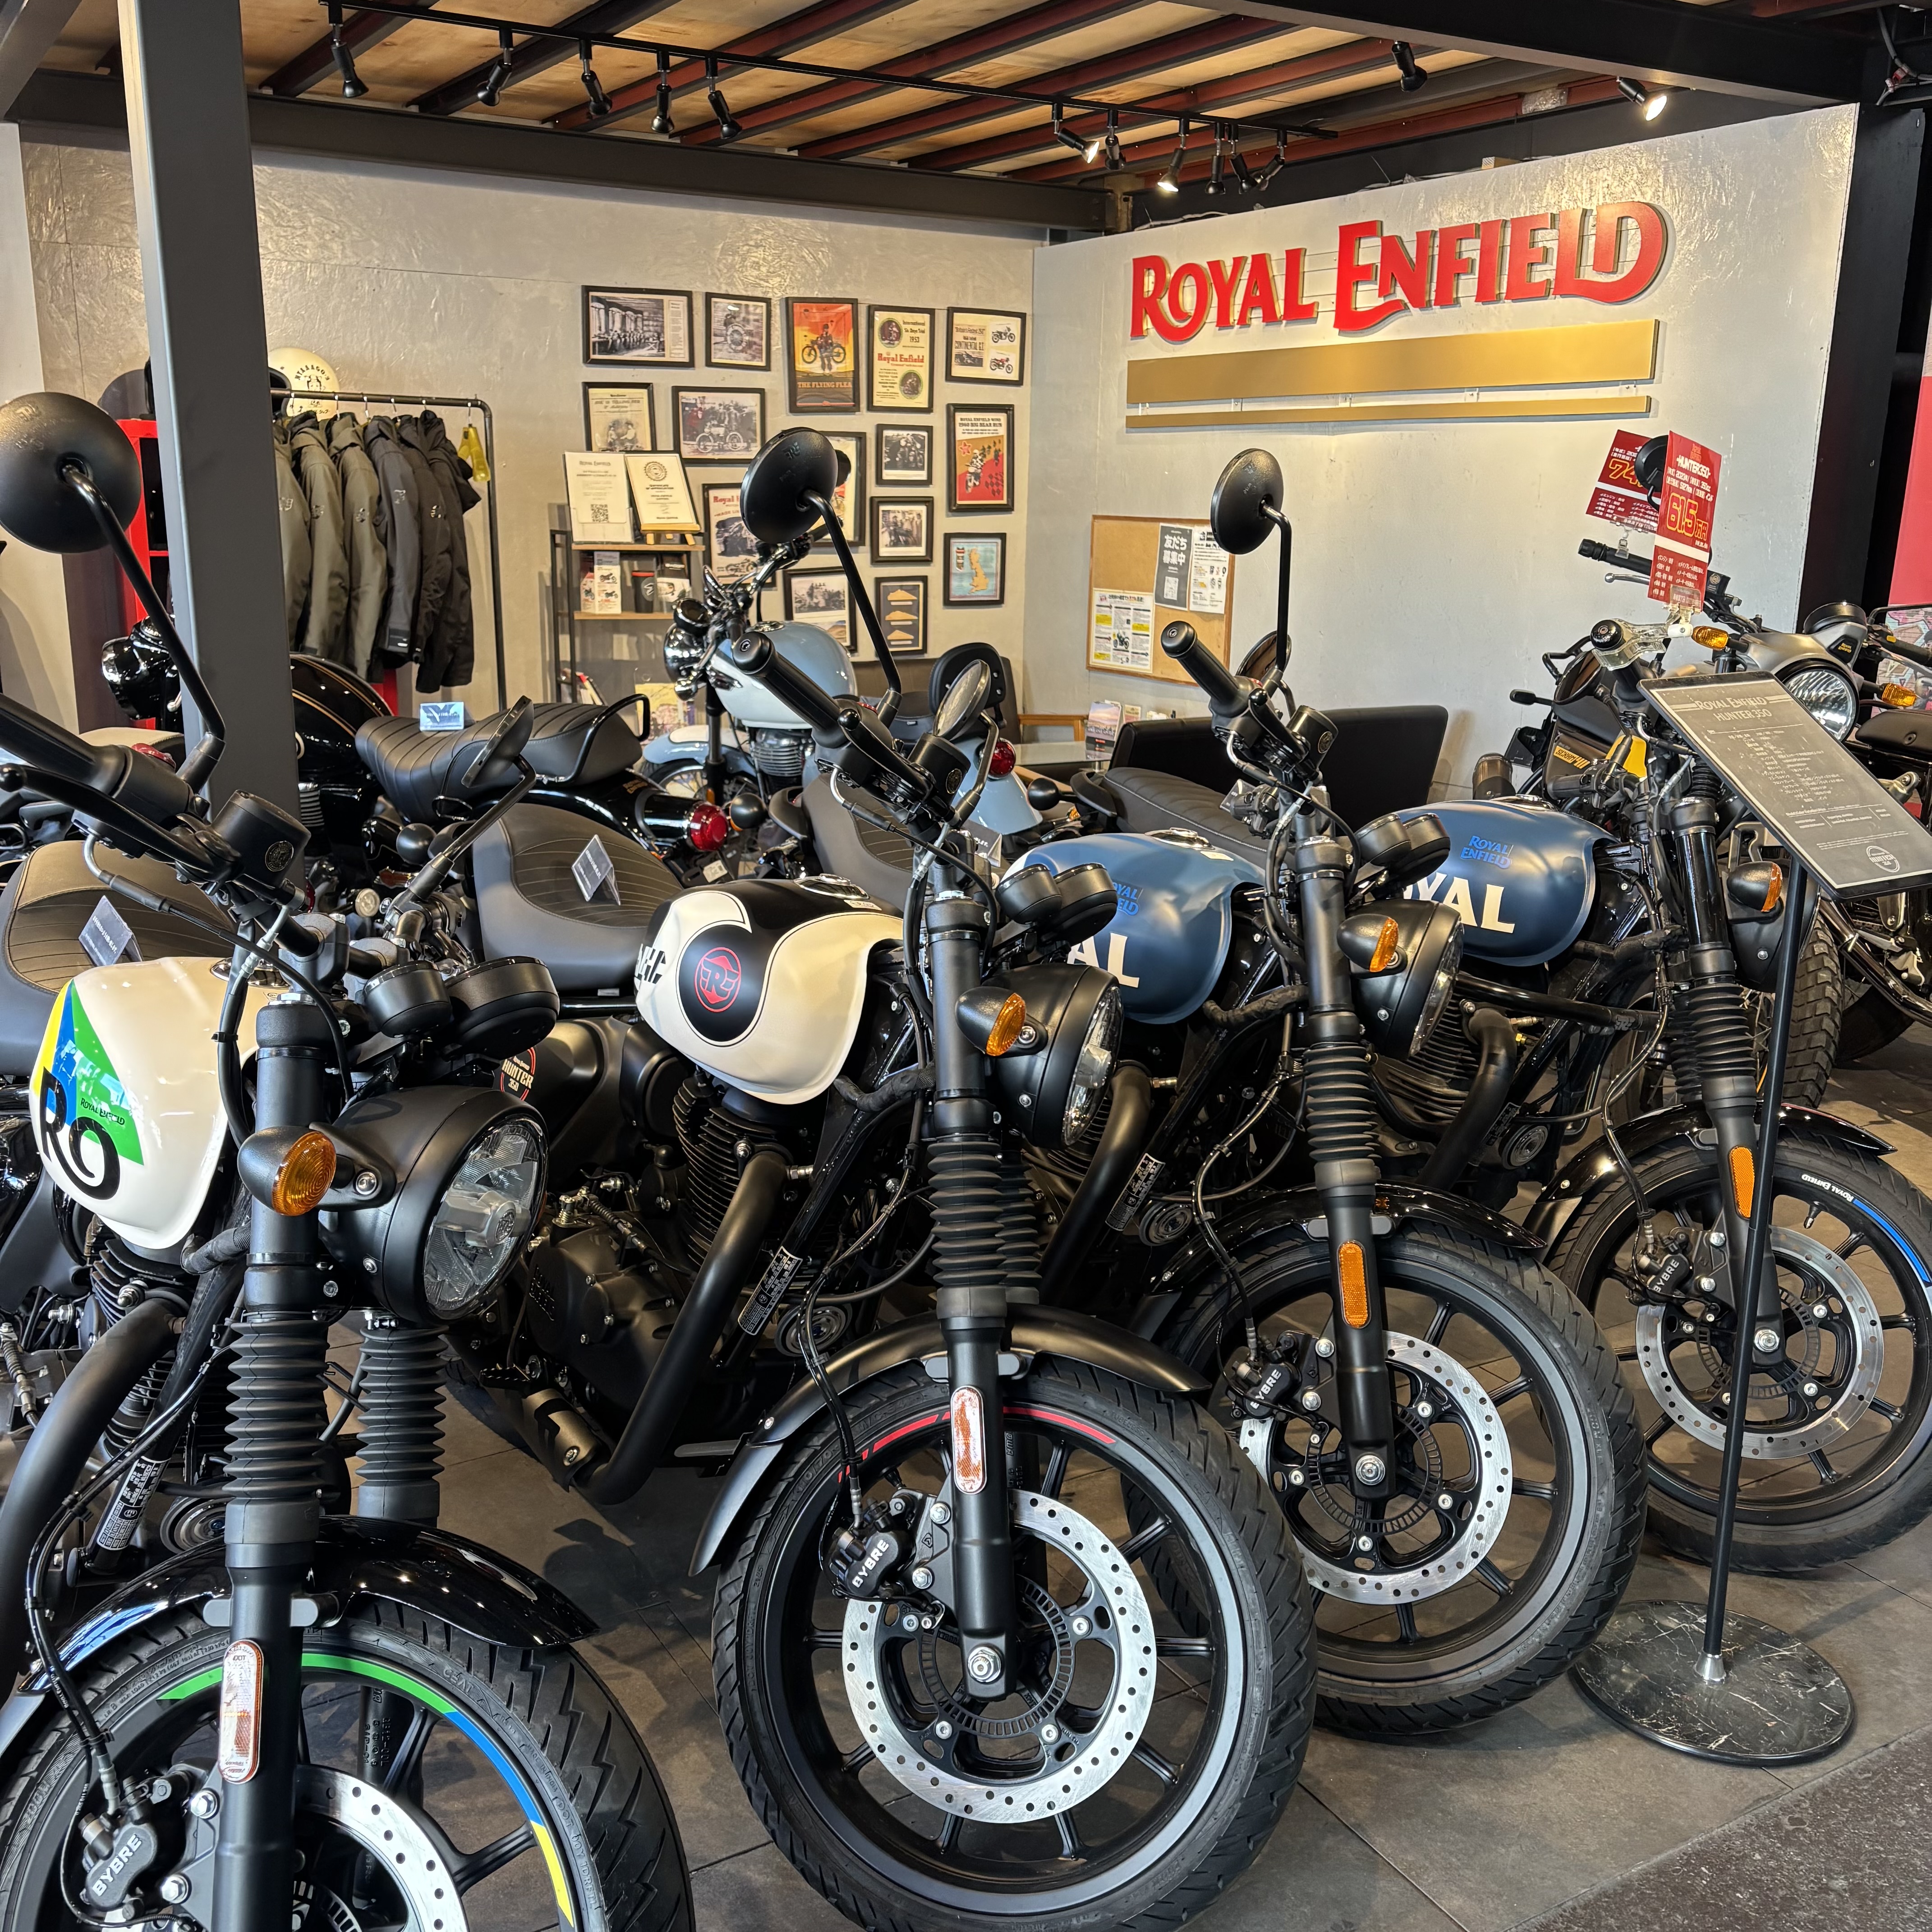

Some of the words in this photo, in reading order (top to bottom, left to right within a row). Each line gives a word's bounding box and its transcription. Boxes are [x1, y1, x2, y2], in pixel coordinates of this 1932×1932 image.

[1130, 248, 1320, 343] ROYAL
[1334, 201, 1668, 335] ENFIELD
[878, 353, 898, 363] Royal
[899, 354, 924, 363] Enfield
[713, 496, 734, 504] Royal
[1695, 700, 1730, 710] ROYAL
[1726, 697, 1767, 708] ENFIELD
[1713, 710, 1753, 722] HUNTER
[1752, 709, 1772, 718] 350
[1469, 835, 1509, 856] ROYAL
[1461, 846, 1512, 869] ENFIELD
[501, 1058, 534, 1089] HUNTER
[80, 1098, 98, 1113] ROYAL
[1801, 1173, 1831, 1191] ENFIELD
[1831, 1185, 1854, 1203] ROYAL
[1651, 1259, 1680, 1294] BYBRE
[851, 1538, 890, 1588] BYBRE
[443, 1668, 474, 1694] CEAT
[556, 1798, 574, 1827] DOT
[92, 1833, 143, 1897] BYBRE
